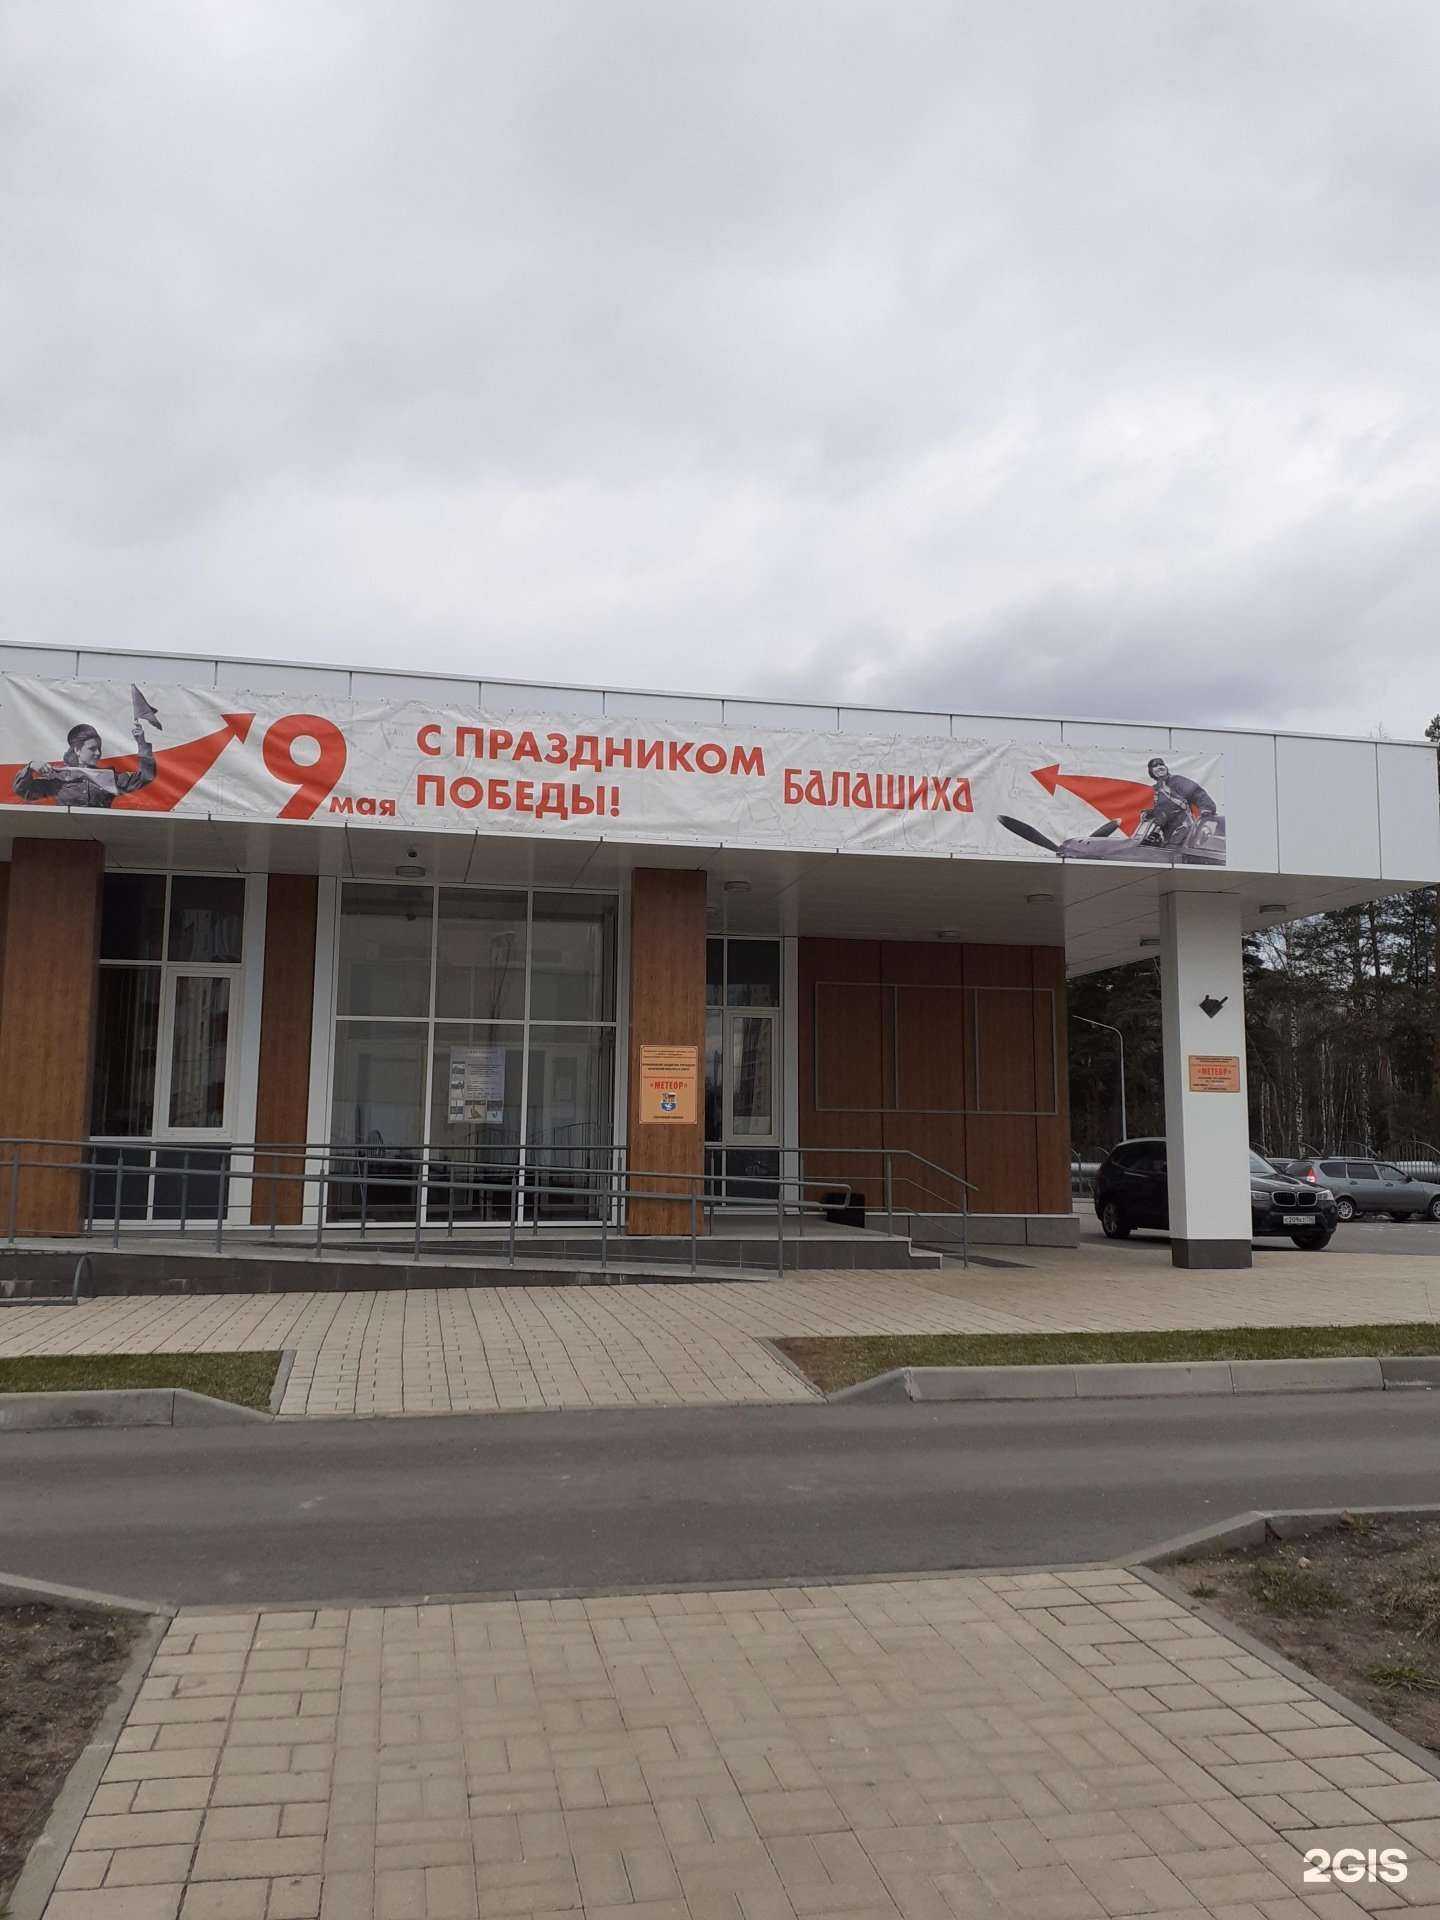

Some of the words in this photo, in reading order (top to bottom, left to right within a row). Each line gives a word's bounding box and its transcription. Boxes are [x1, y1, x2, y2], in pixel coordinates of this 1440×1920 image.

[262, 713, 347, 821] 9
[329, 797, 396, 817] мая
[416, 724, 442, 757] С
[455, 727, 765, 777] ПРАЗДНИКОМ
[416, 774, 620, 820] ПОБЕДЫ!
[783, 768, 974, 813] БАЛАШИХА
